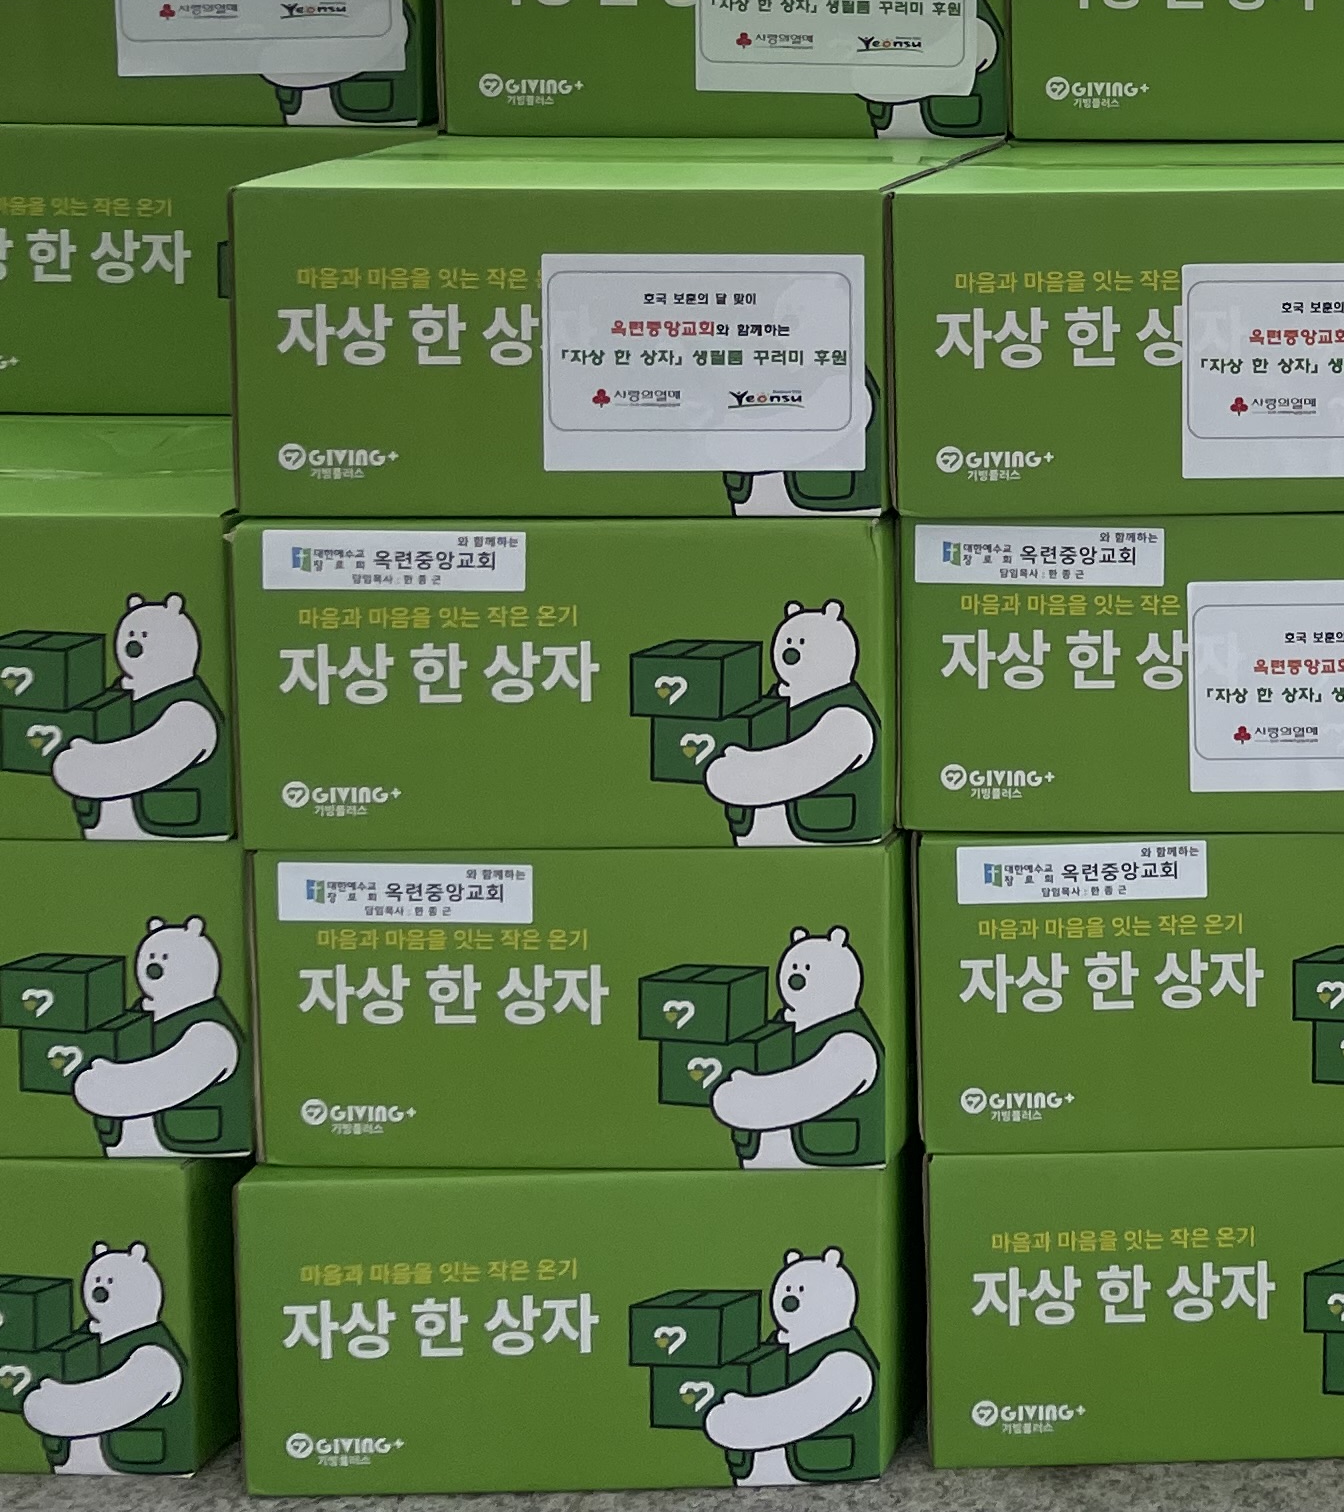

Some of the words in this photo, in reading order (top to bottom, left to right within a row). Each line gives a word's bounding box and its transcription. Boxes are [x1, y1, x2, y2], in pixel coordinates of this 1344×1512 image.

[1071, 81, 1150, 98] GIVING+
[25, 228, 77, 283] 한
[89, 229, 192, 285] 상자
[276, 303, 394, 367] 자상
[408, 303, 467, 365] 한
[934, 306, 1050, 370] 자상
[1064, 305, 1121, 367] 한
[307, 448, 399, 467] GIVING+
[965, 450, 1055, 469] GIVING+
[372, 550, 496, 571] 옥련중앙교회
[279, 642, 395, 706] 자상
[409, 642, 468, 704] 한
[483, 640, 600, 704] 상자
[940, 628, 1051, 690] 자상
[1065, 629, 1121, 690] 한
[311, 786, 402, 804] GIVING+
[1060, 860, 1178, 883] 옥련중앙교회
[298, 963, 411, 1025] 자상
[425, 963, 482, 1025] 한
[496, 963, 610, 1026] 상자
[959, 952, 1070, 1014] 자상
[1084, 950, 1140, 1011] 한
[1153, 947, 1265, 1009] 상자
[988, 1091, 1075, 1110] GIVING+
[971, 1265, 1082, 1327] 자상
[1096, 1263, 1152, 1324] 한
[1166, 1260, 1276, 1323] 상자
[282, 1298, 397, 1360] 자상
[410, 1296, 469, 1358] 한
[483, 1292, 600, 1356] 상자
[1000, 1404, 1086, 1423] GIVING+
